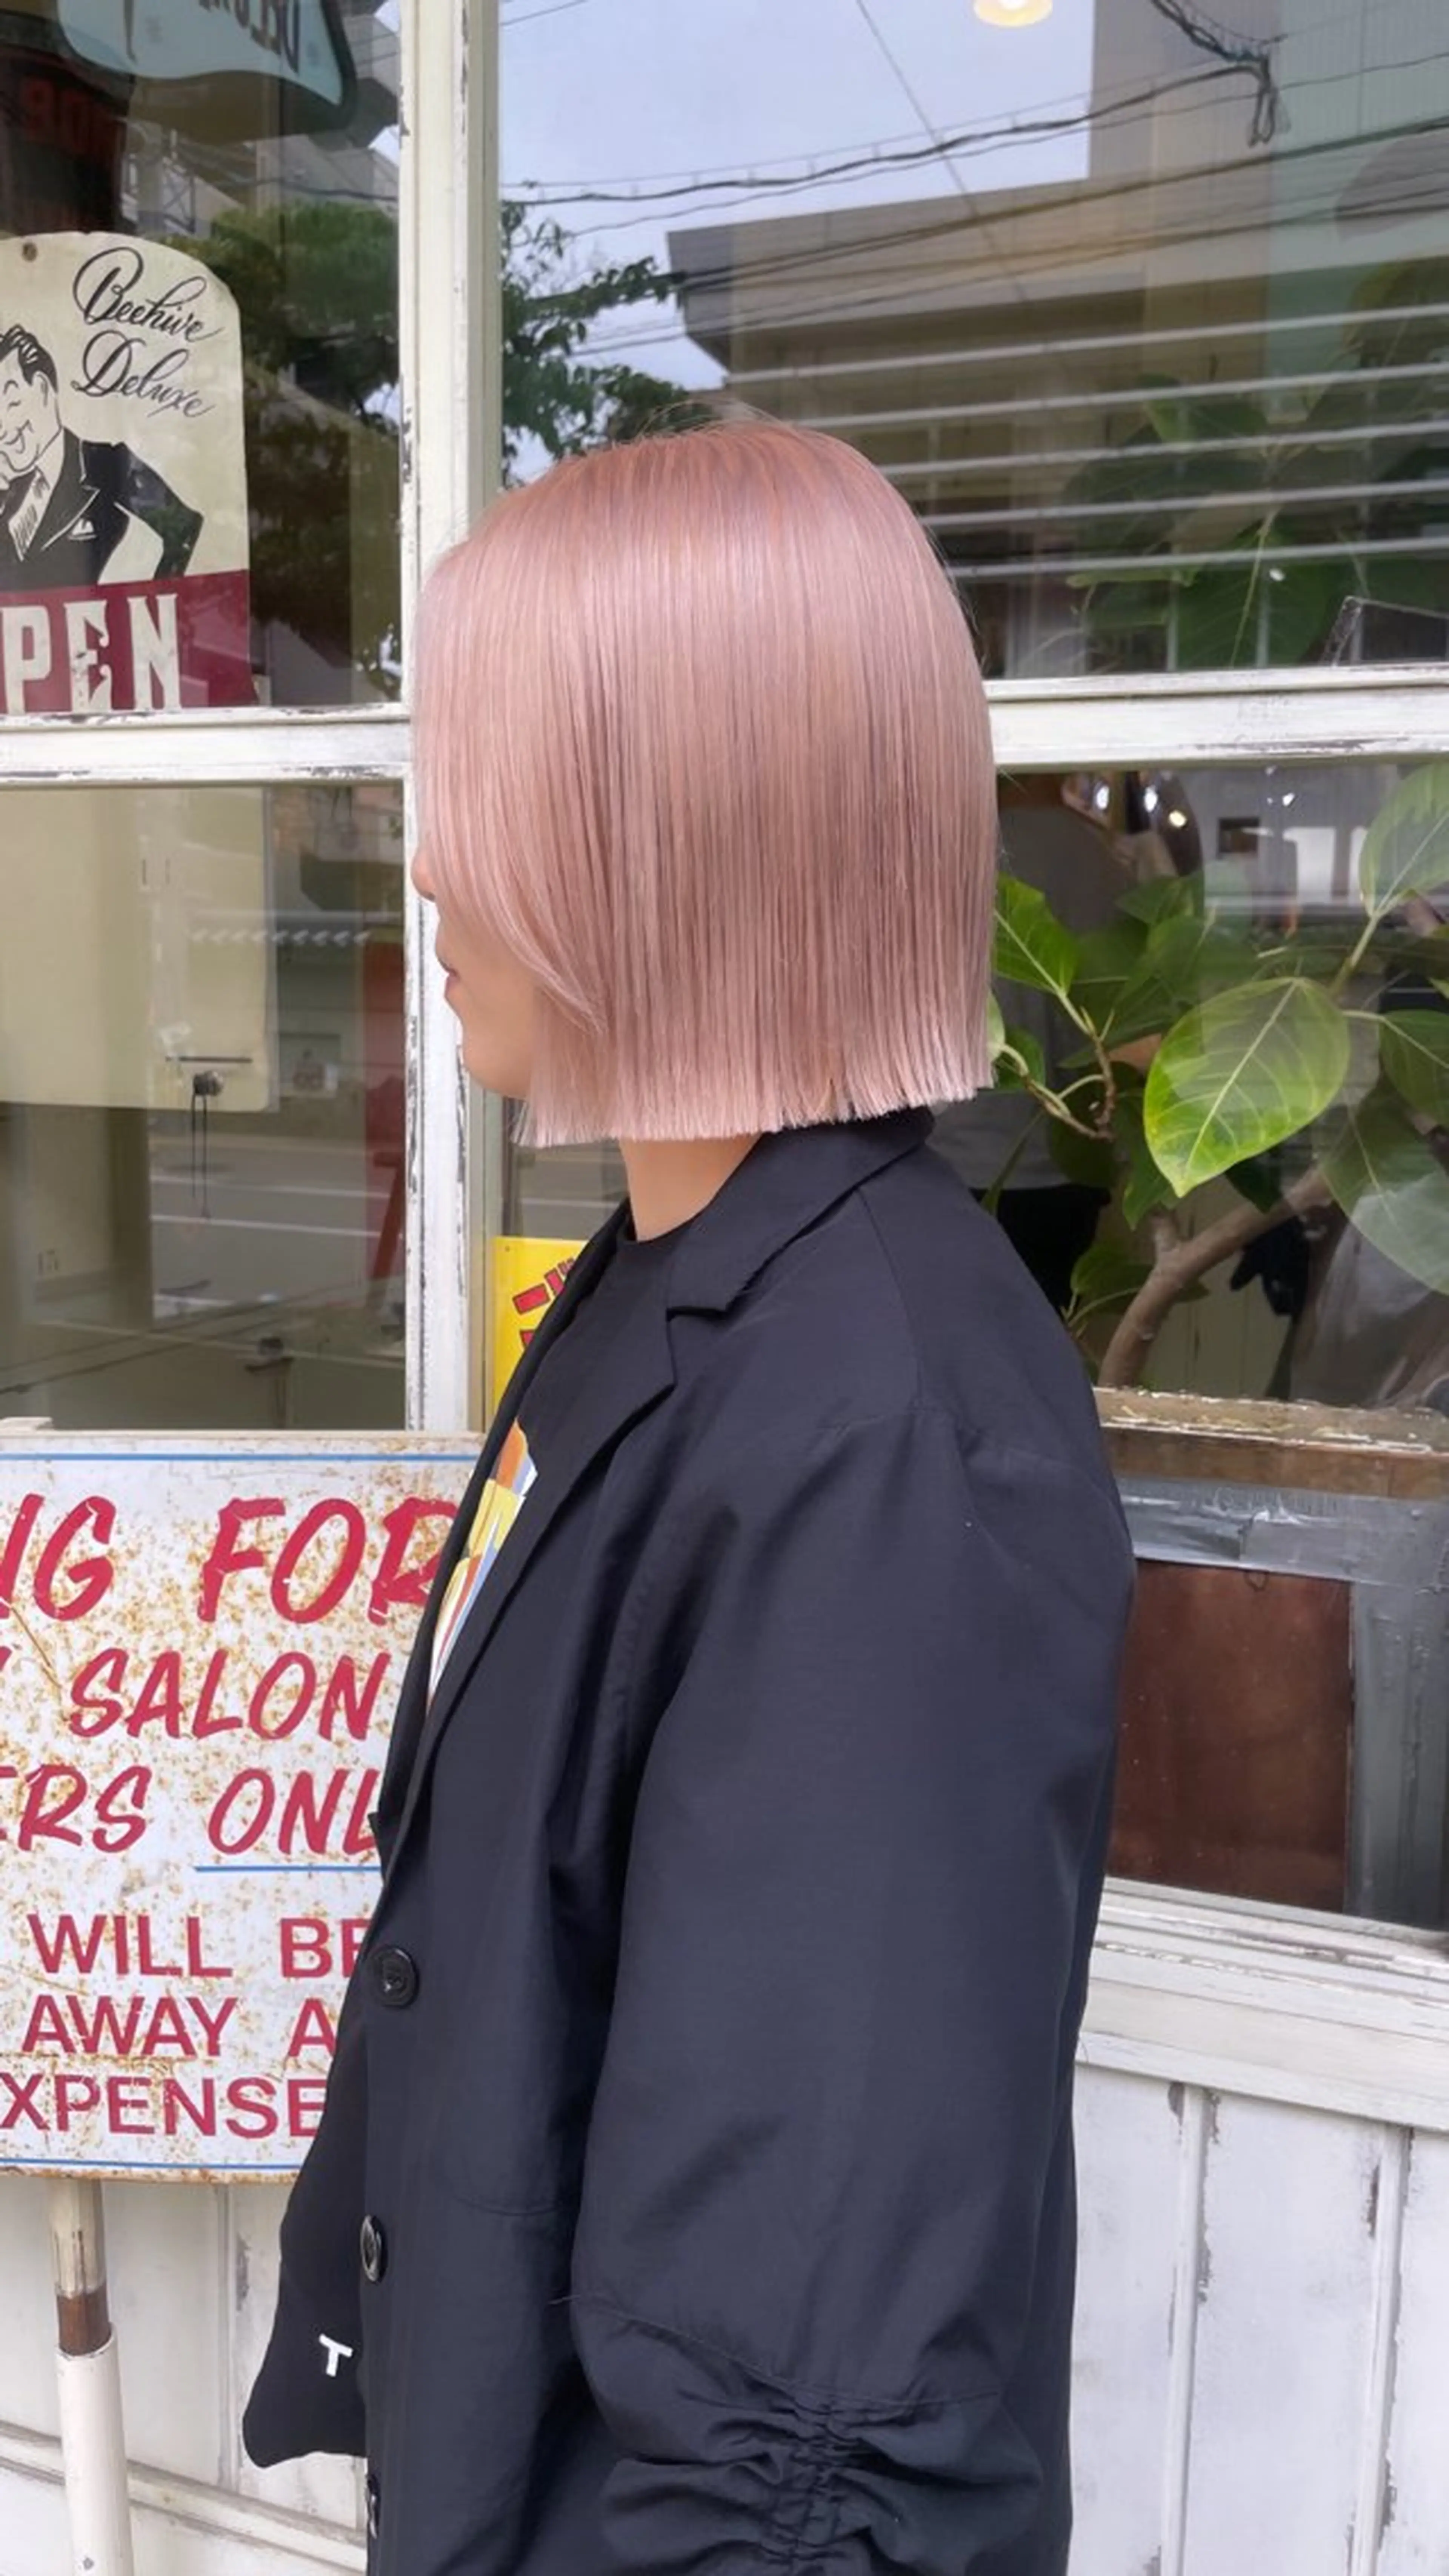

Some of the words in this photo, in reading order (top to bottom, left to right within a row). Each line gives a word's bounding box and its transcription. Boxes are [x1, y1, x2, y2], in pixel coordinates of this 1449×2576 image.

[73, 246, 225, 341] Beehive
[71, 329, 216, 417] Deluxe
[197, 1495, 460, 1625] FOR
[69, 1648, 392, 1740] SALON
[0, 1763, 151, 1852] RS
[27, 1914, 233, 1978] WILL
[21, 1995, 238, 2057] AWAY
